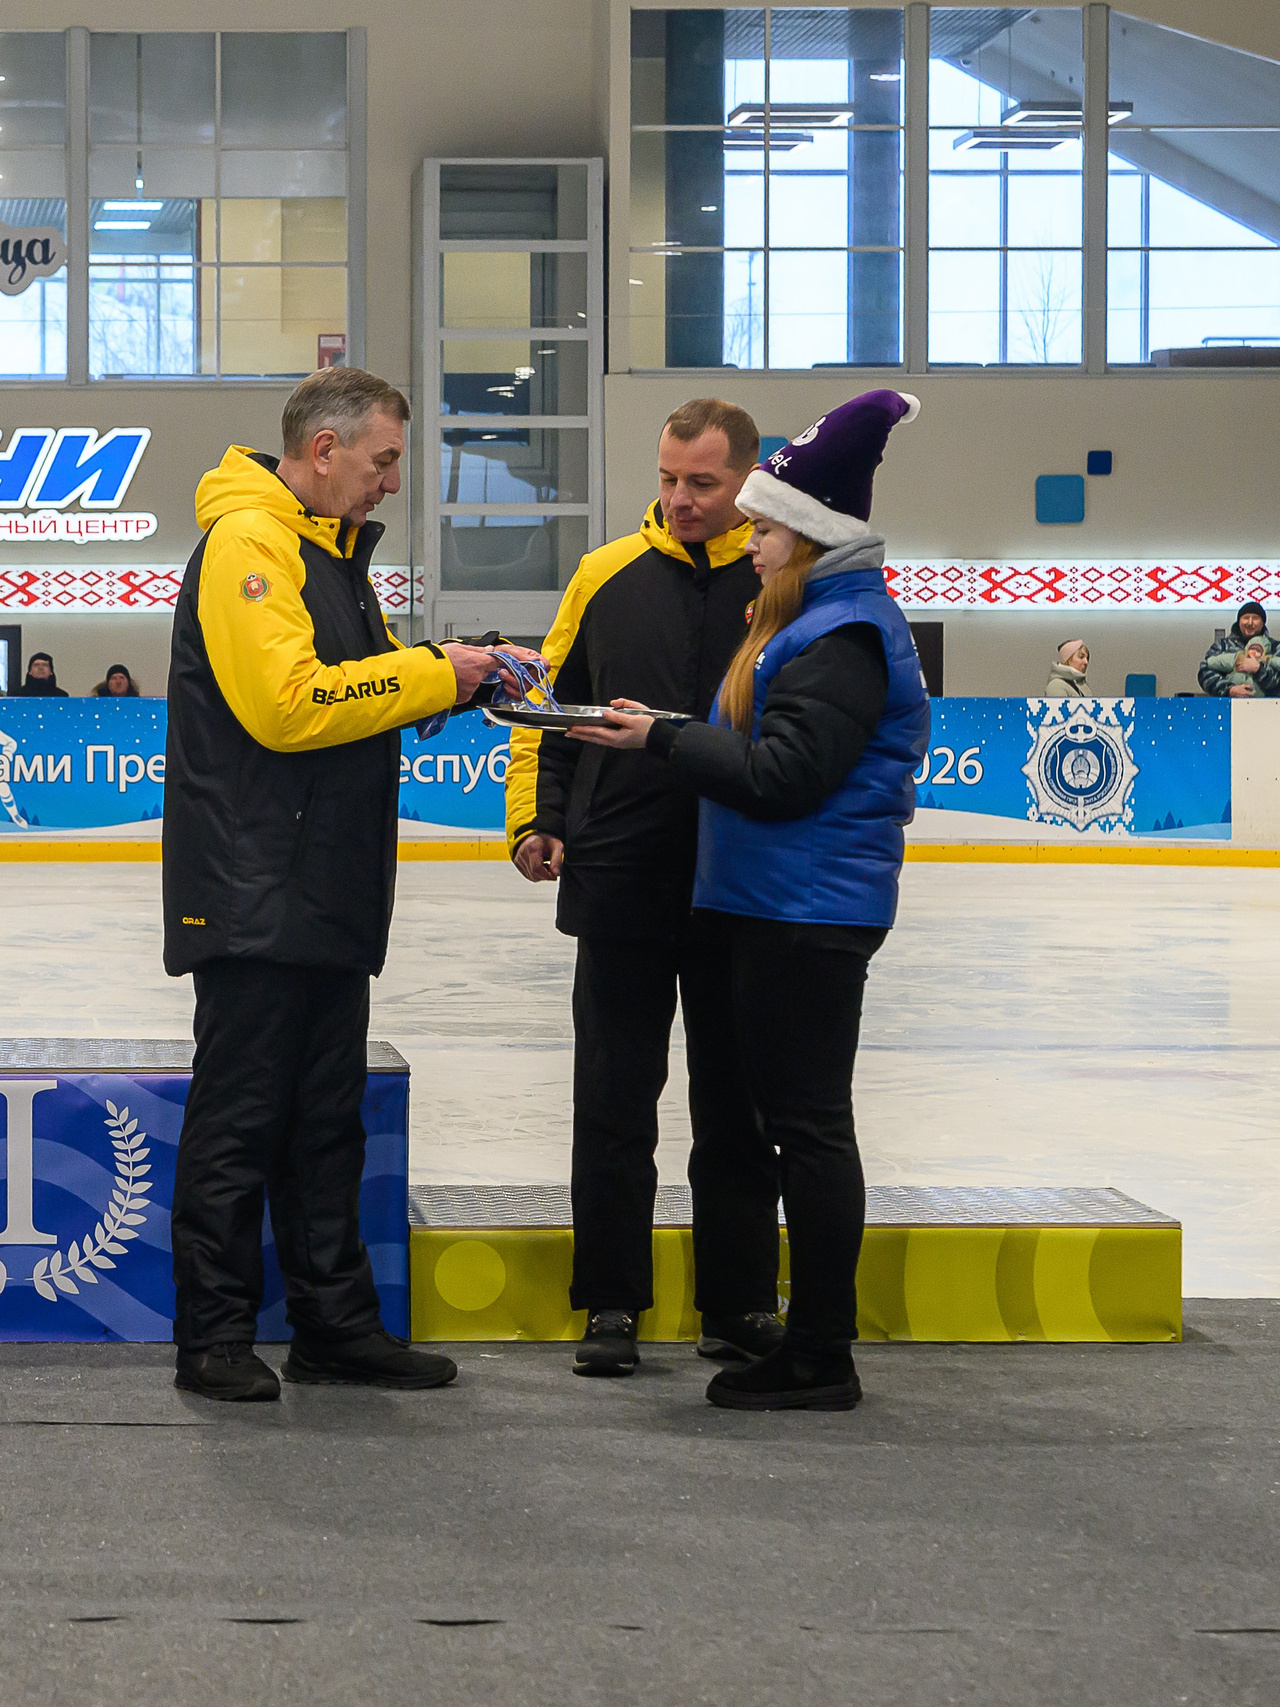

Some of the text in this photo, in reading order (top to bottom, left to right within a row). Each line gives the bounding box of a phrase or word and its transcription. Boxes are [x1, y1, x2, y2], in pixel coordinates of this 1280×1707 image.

[66, 520, 151, 538] ЦЕНТР
[312, 676, 401, 706] BELARUS
[86, 744, 167, 793] Пре
